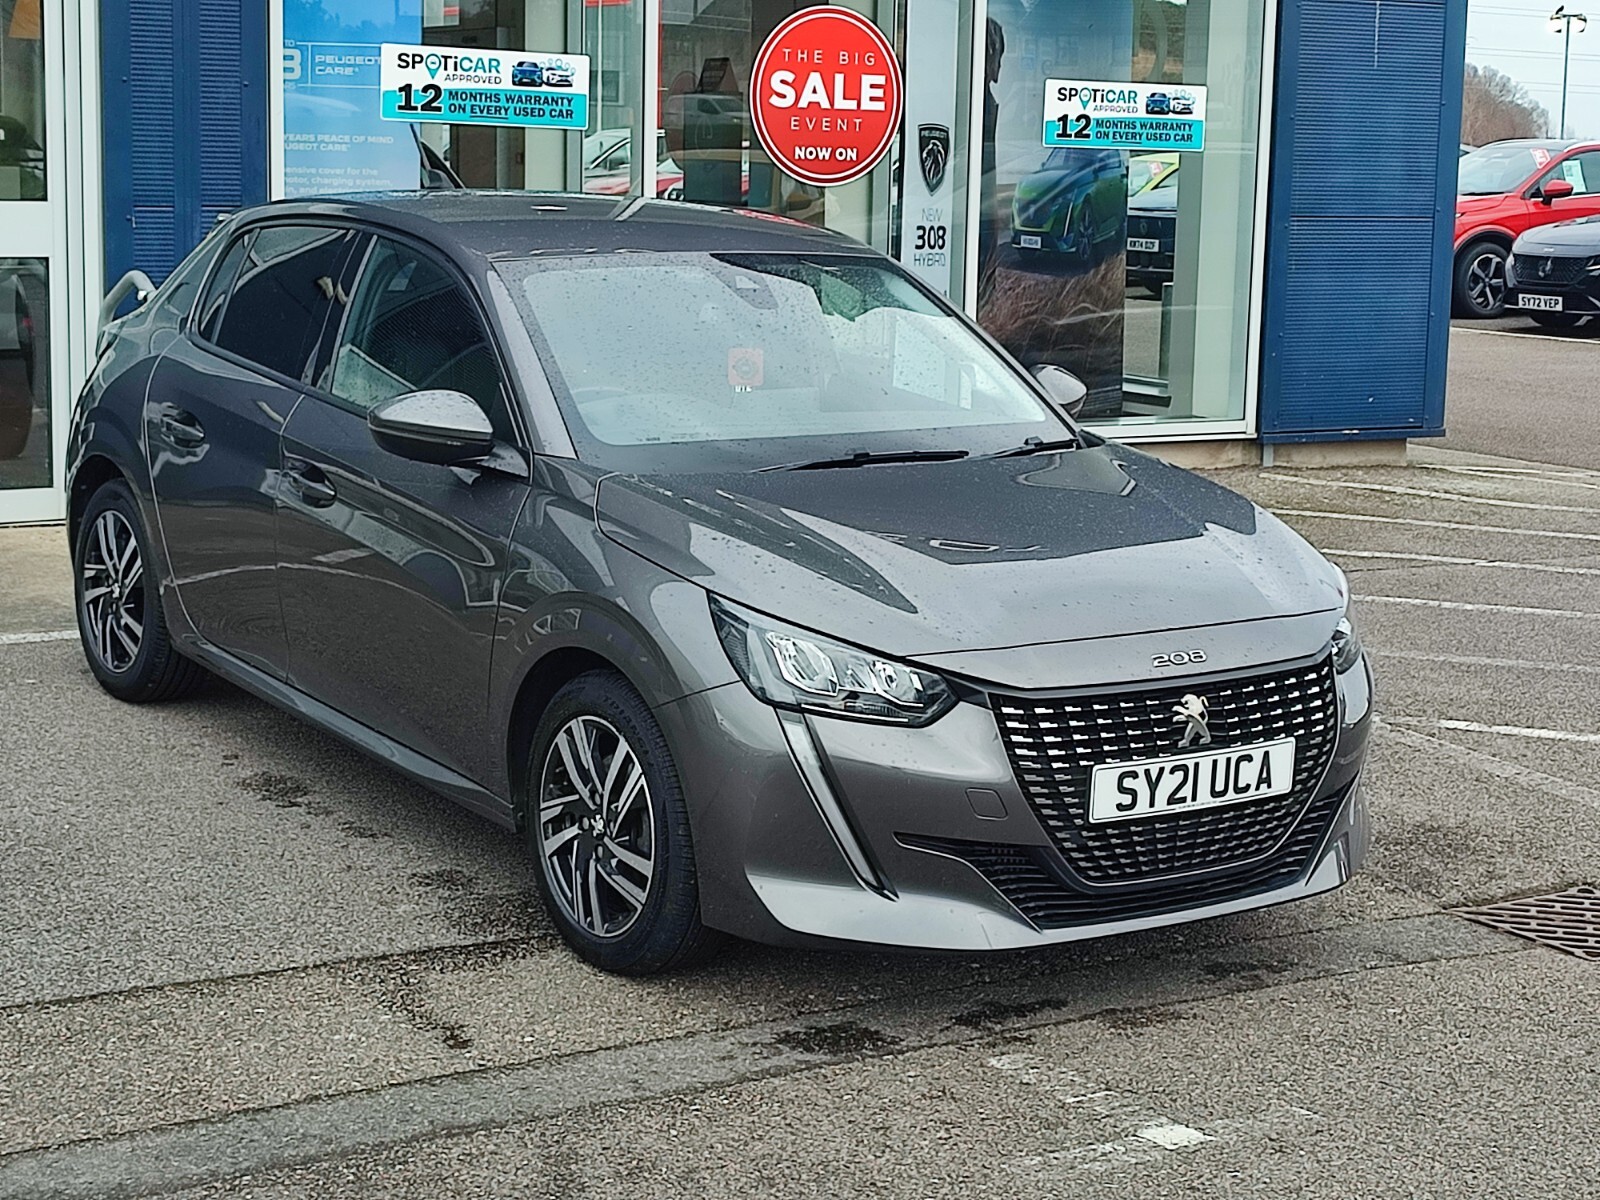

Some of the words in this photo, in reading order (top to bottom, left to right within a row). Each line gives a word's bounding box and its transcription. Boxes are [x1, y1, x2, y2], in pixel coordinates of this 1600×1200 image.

[782, 48, 823, 64] THE
[839, 51, 875, 66] BIG
[444, 73, 502, 85] APPROVED
[397, 83, 443, 112] 12
[768, 70, 886, 111] SALE
[448, 91, 501, 104] MONTHS
[505, 93, 574, 107] WARRANTY
[449, 104, 467, 114] ON
[470, 105, 510, 117] EVERY
[513, 106, 545, 118] USED
[549, 108, 574, 120] CAR
[1093, 105, 1139, 114] APPROVED
[790, 116, 863, 132] EVENT
[1056, 113, 1092, 139] 12
[1095, 119, 1137, 130] MONTHS
[1139, 121, 1194, 132] WARRANTY
[317, 134, 350, 143] PEACE
[352, 135, 366, 143] OF
[367, 136, 394, 144] MIND
[1095, 130, 1110, 139] ON
[1112, 131, 1143, 141] EVERY
[1146, 132, 1171, 142] USED
[1174, 133, 1193, 143] CAR
[794, 146, 832, 160] NOW
[835, 147, 858, 161] ON
[318, 167, 344, 175] cover
[346, 167, 361, 176] for
[362, 168, 379, 176] the
[922, 208, 943, 222] NEW
[914, 225, 947, 250] 308
[1521, 296, 1542, 308] SY72
[1543, 298, 1560, 309] YEP
[1151, 649, 1208, 668] 208
[1115, 761, 1200, 812] SY21
[1209, 750, 1273, 799] UCA
